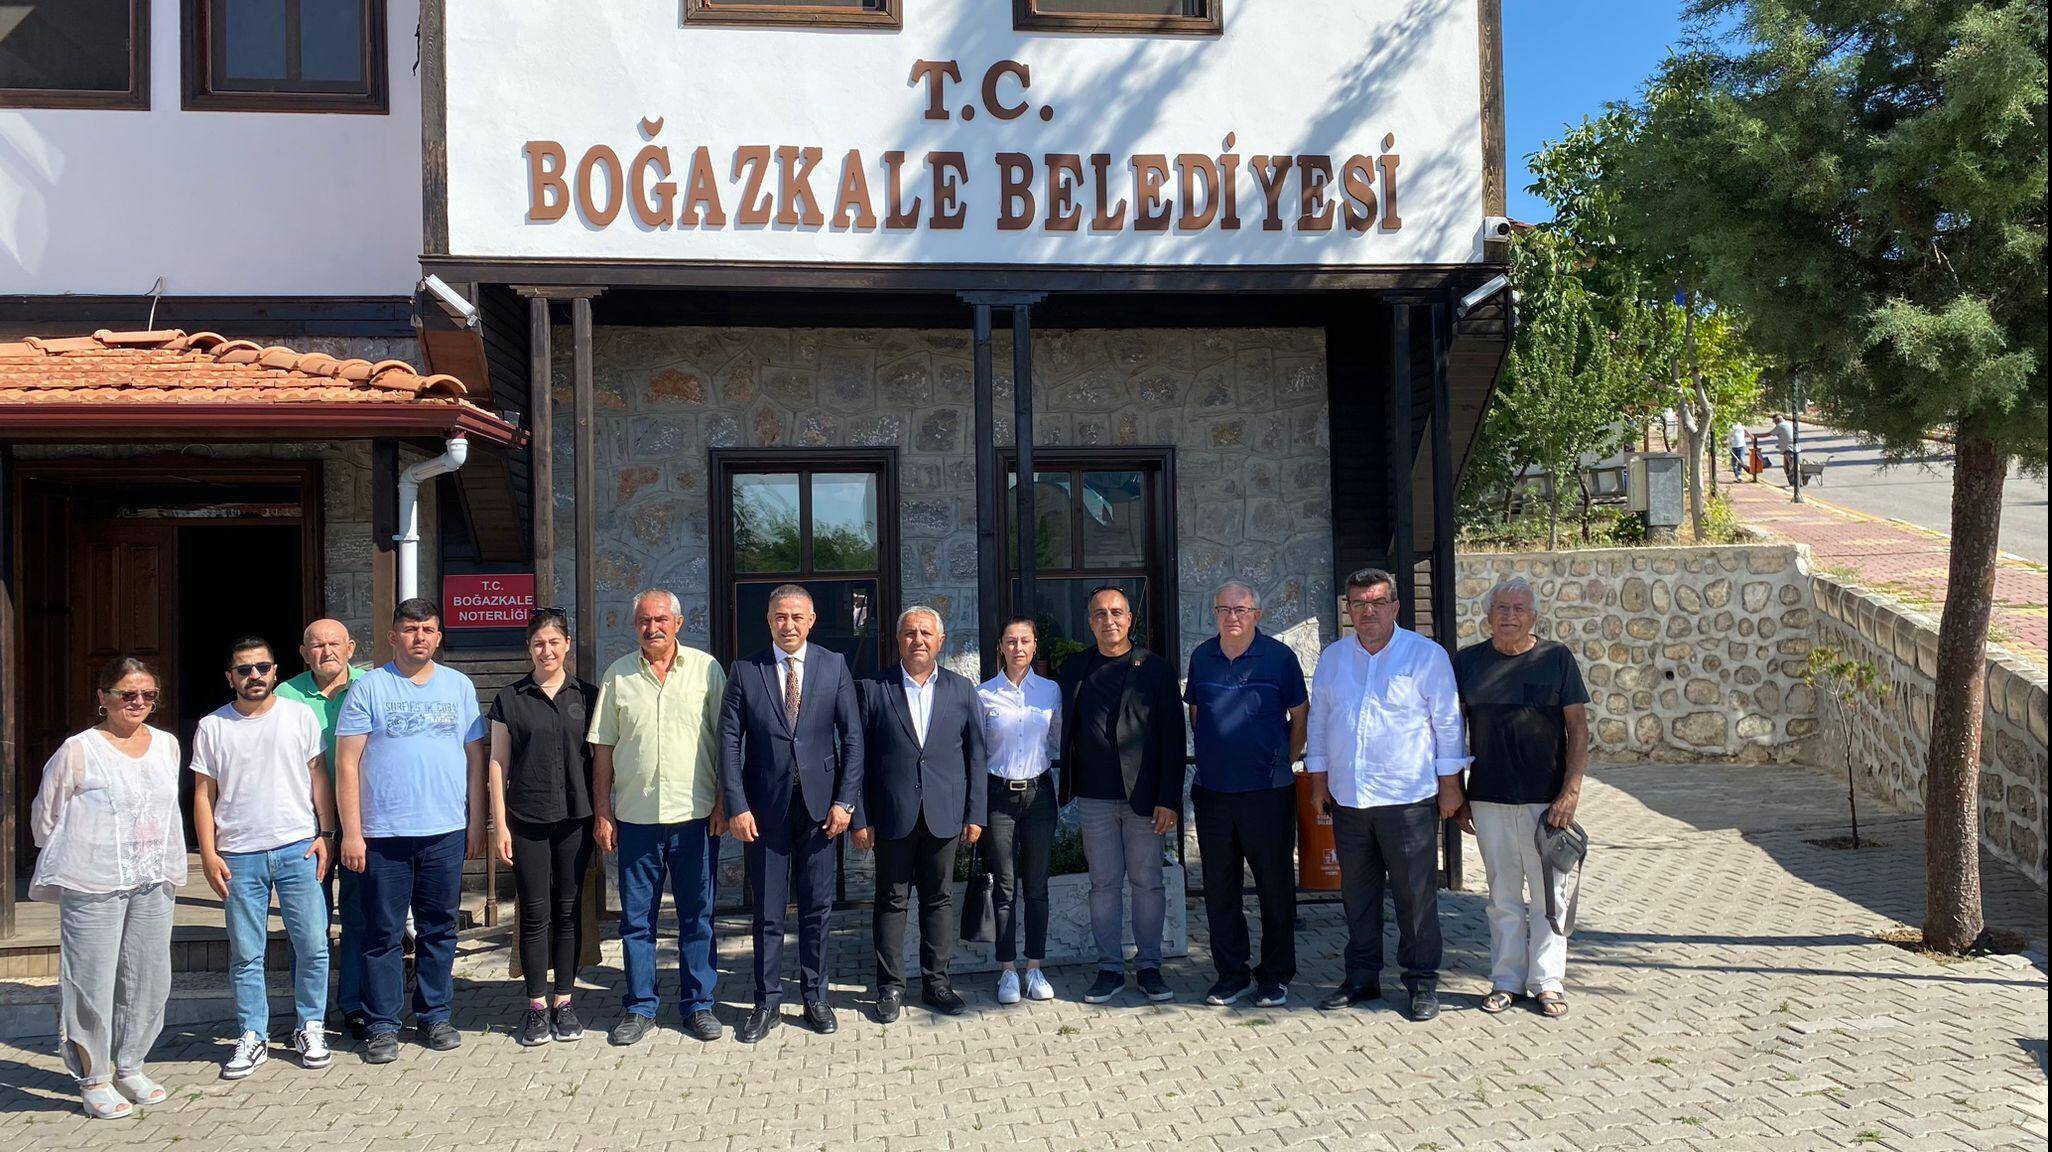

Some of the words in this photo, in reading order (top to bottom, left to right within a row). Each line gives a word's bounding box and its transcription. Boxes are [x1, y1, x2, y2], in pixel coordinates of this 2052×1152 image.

[914, 59, 1054, 122] T.C.
[525, 116, 968, 228] BOĞAZKALE
[996, 132, 1402, 231] BELEDİYESİ
[482, 581, 504, 591] T.C.
[453, 594, 533, 607] BOĞAZKALE
[459, 608, 528, 621] NOTERLİĞİ
